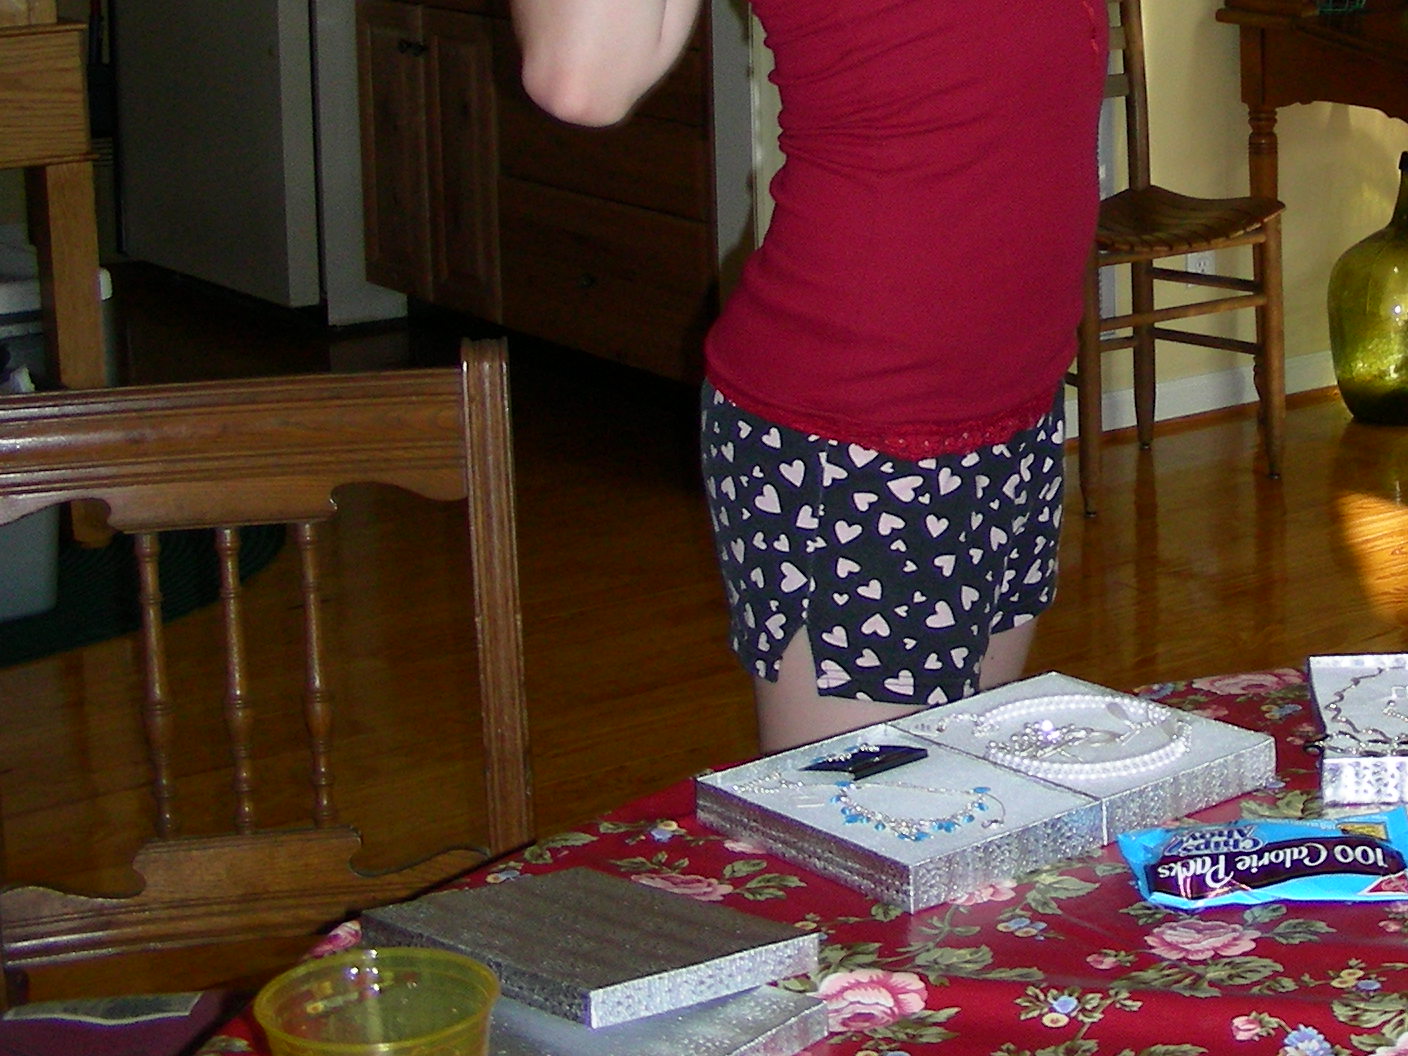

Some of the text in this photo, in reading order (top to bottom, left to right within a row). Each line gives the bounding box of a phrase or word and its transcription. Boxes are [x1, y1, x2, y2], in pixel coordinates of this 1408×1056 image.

[1157, 842, 1389, 889] 100 Calorie Packs
